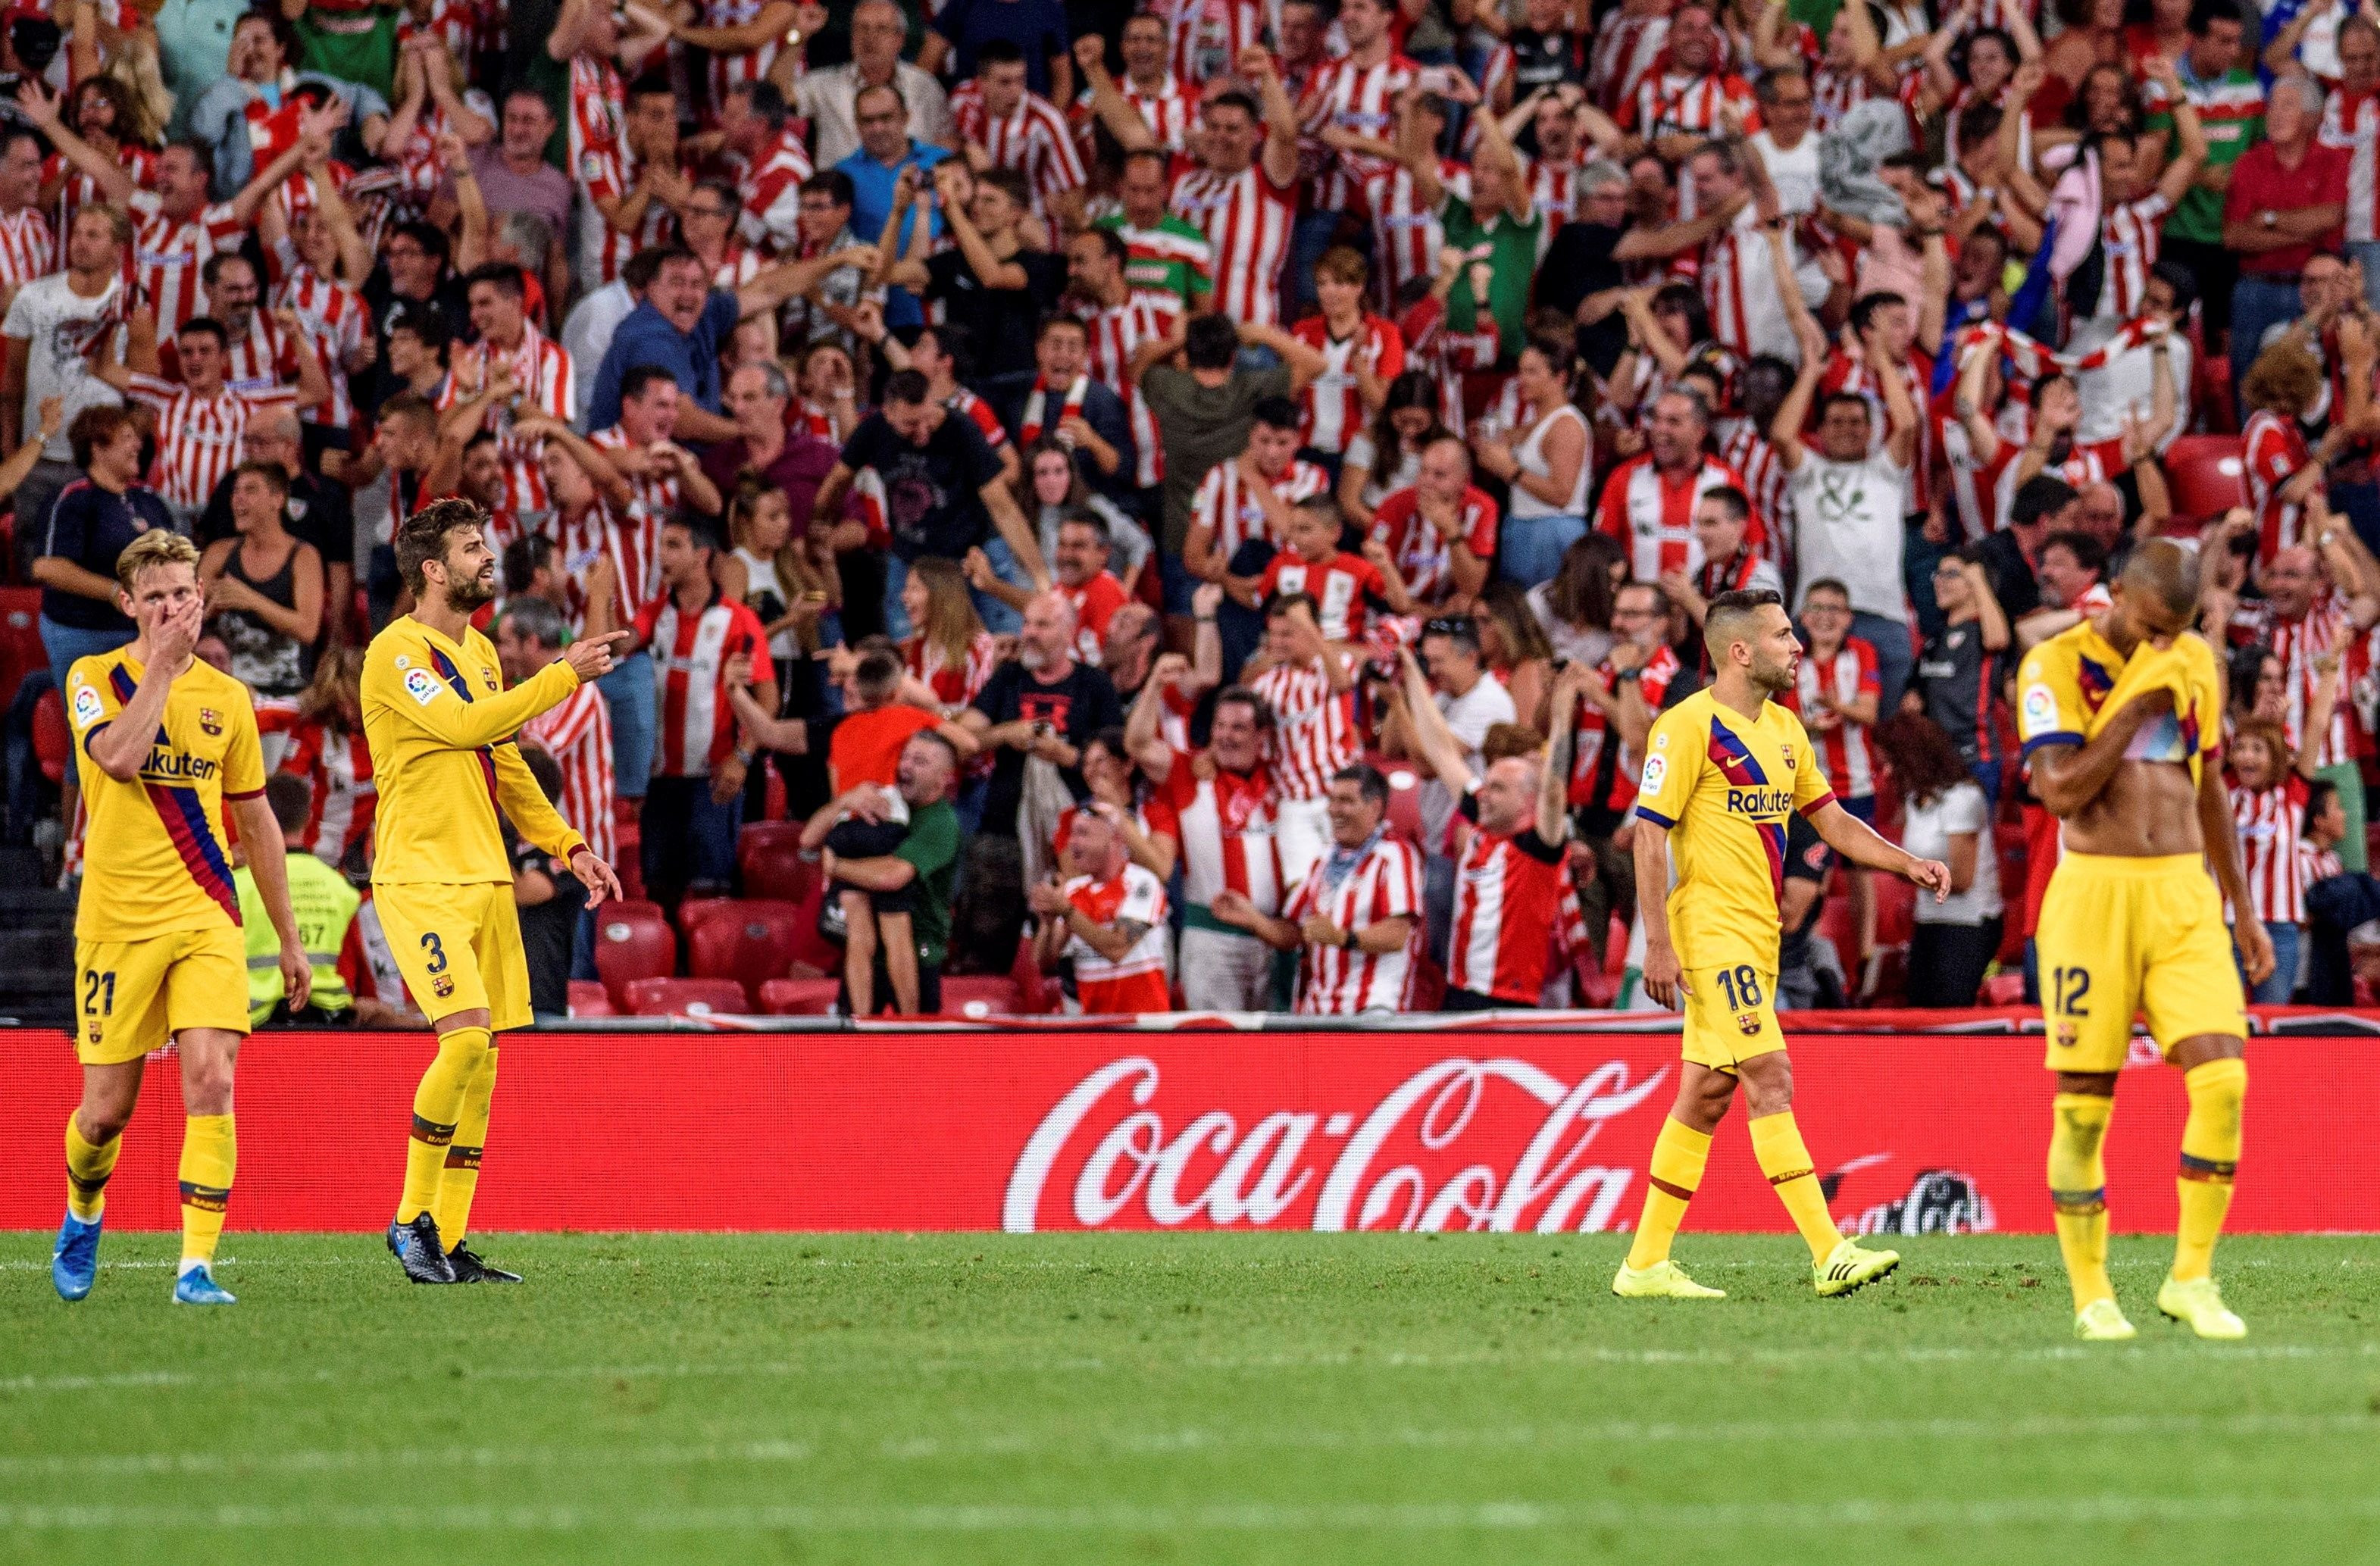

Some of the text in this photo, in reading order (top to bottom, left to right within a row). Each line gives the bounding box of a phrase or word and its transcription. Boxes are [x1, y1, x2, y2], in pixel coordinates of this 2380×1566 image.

[139, 746, 216, 780] kuten
[421, 932, 447, 974] 3
[85, 970, 115, 1016] 21
[1716, 964, 1762, 1012] 18
[2054, 967, 2090, 1016] 12
[1002, 1055, 1672, 1233] Coca-Cola
